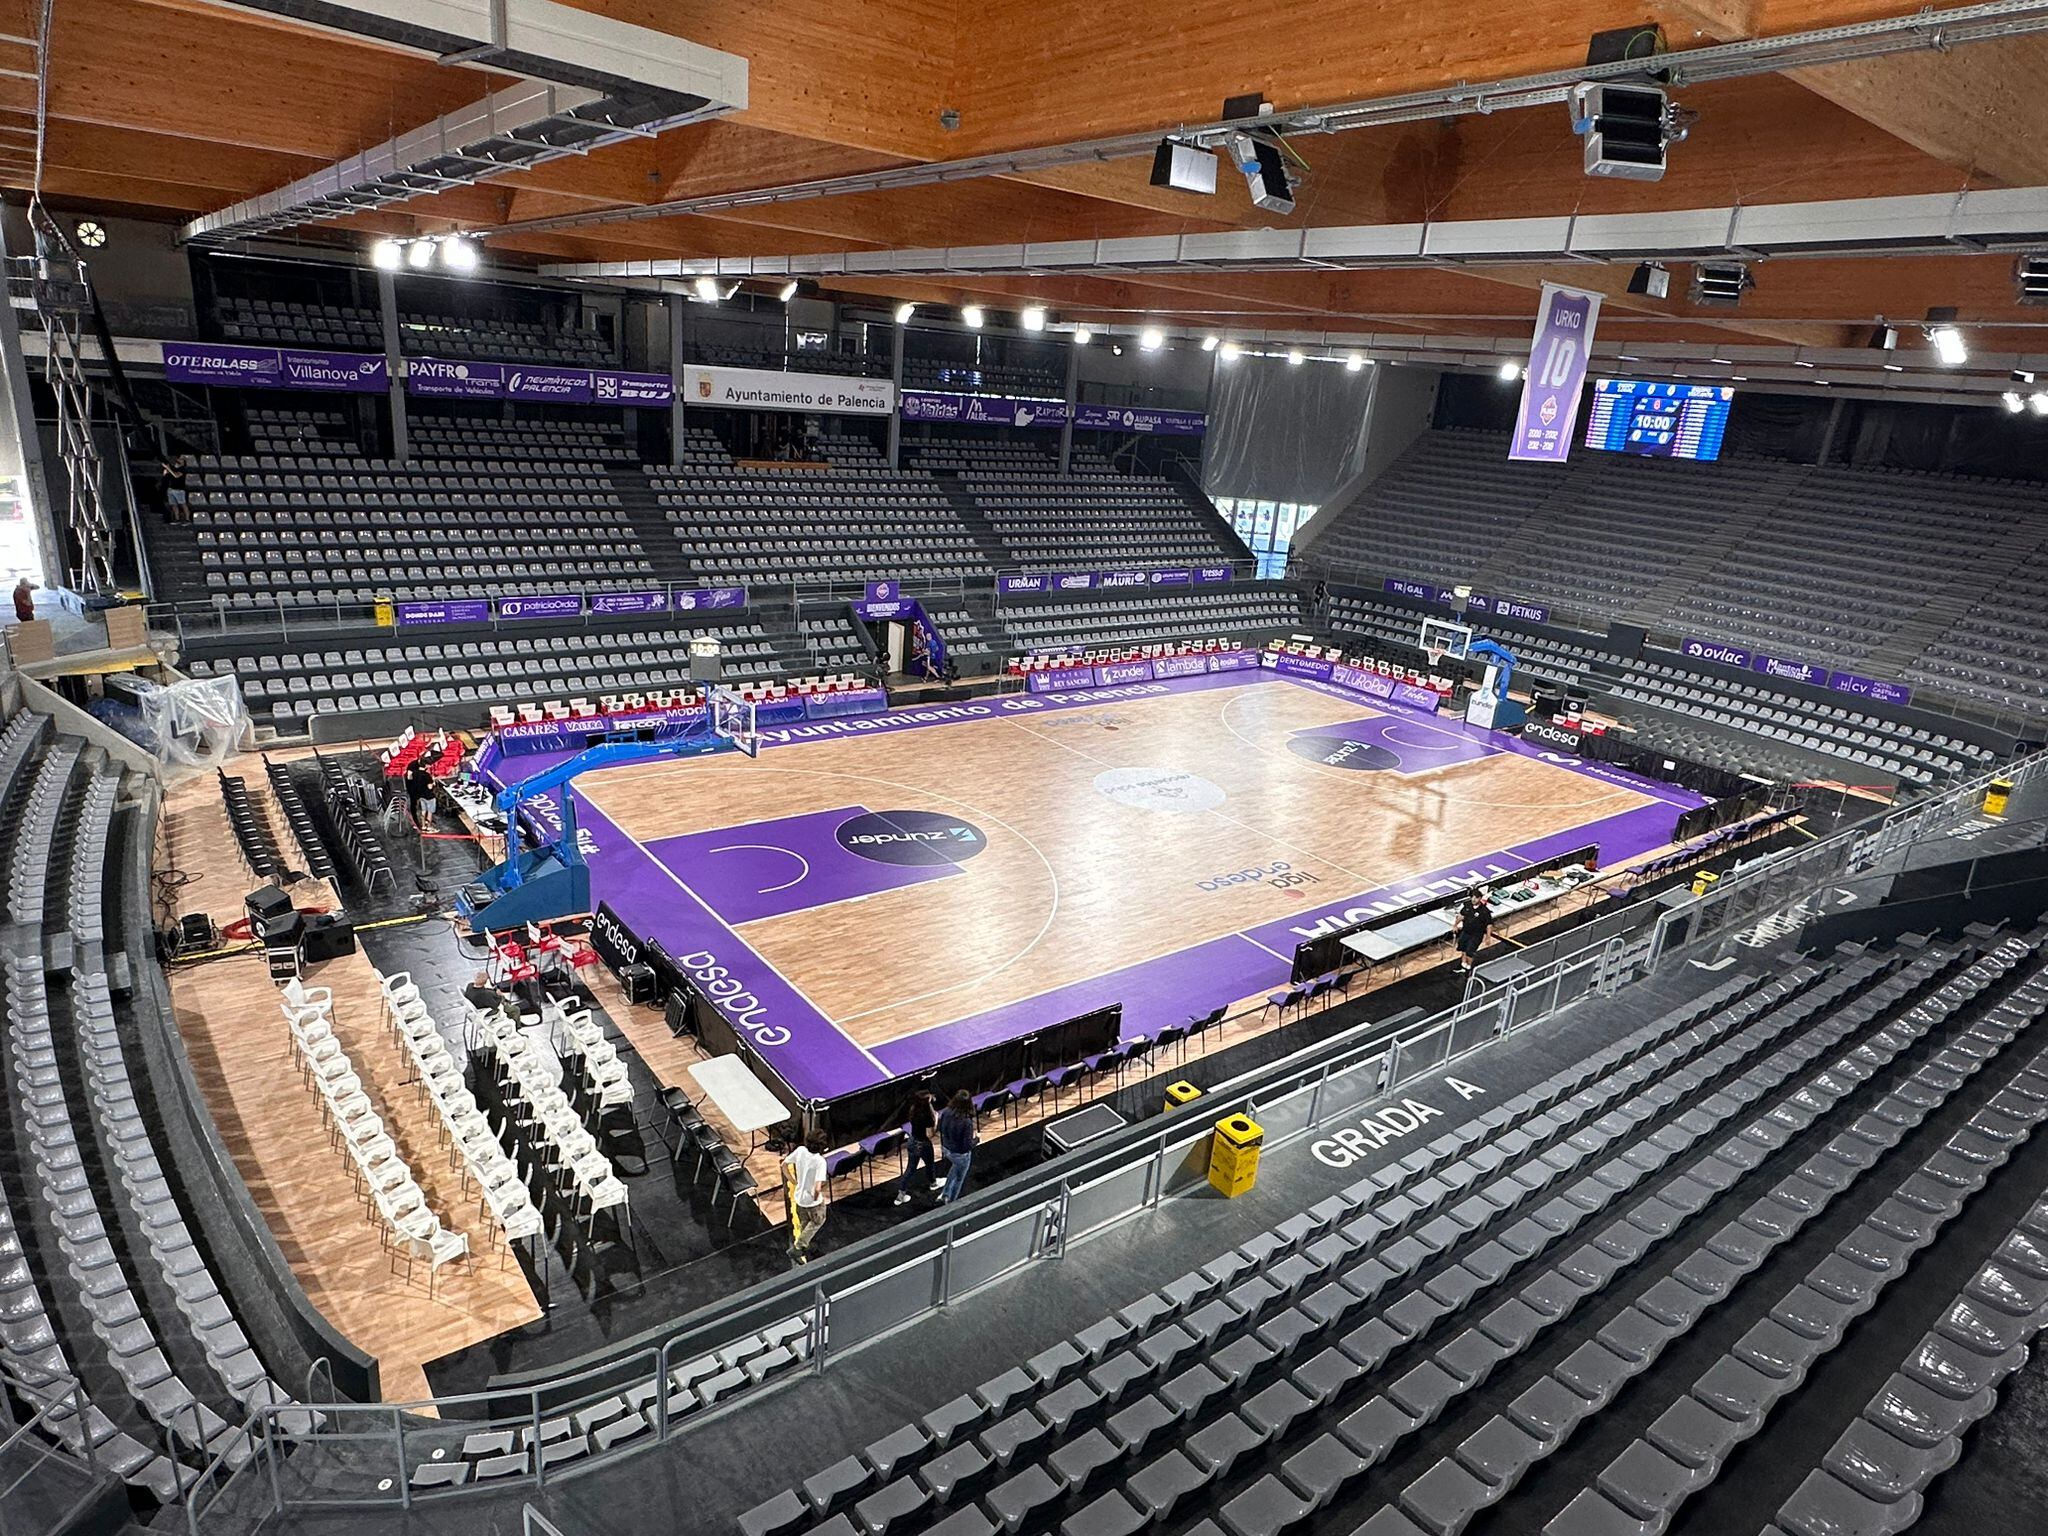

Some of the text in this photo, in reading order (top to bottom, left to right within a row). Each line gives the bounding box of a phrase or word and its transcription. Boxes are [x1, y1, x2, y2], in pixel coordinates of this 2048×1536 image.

[1555, 309, 1581, 329] URKO
[1539, 336, 1577, 388] 10
[288, 364, 359, 381] Villanova
[522, 383, 571, 394] PALENCIA
[725, 387, 885, 409] Ayuntamiento de Palencia
[1036, 406, 1067, 418] RAPTOR
[1636, 415, 1670, 430] 10:00
[1008, 577, 1041, 589] URMAN
[1510, 603, 1543, 621] PETKUS
[1703, 645, 1744, 665] ovlac
[1112, 666, 1144, 679] zunder
[1345, 669, 1390, 696] LuRoPal
[745, 683, 1170, 743] Ayuntamiento de Palencia
[503, 723, 560, 738] CASARES
[1524, 722, 1580, 747] endesa
[1586, 765, 1656, 789] Movistar
[849, 830, 947, 846] zunder
[1195, 860, 1292, 893] endesa
[1267, 870, 1322, 890] liga
[596, 912, 638, 964] endesa
[679, 950, 792, 1047] endesa
[1310, 1097, 1445, 1169] GRADA
[1443, 1076, 1487, 1101] A
